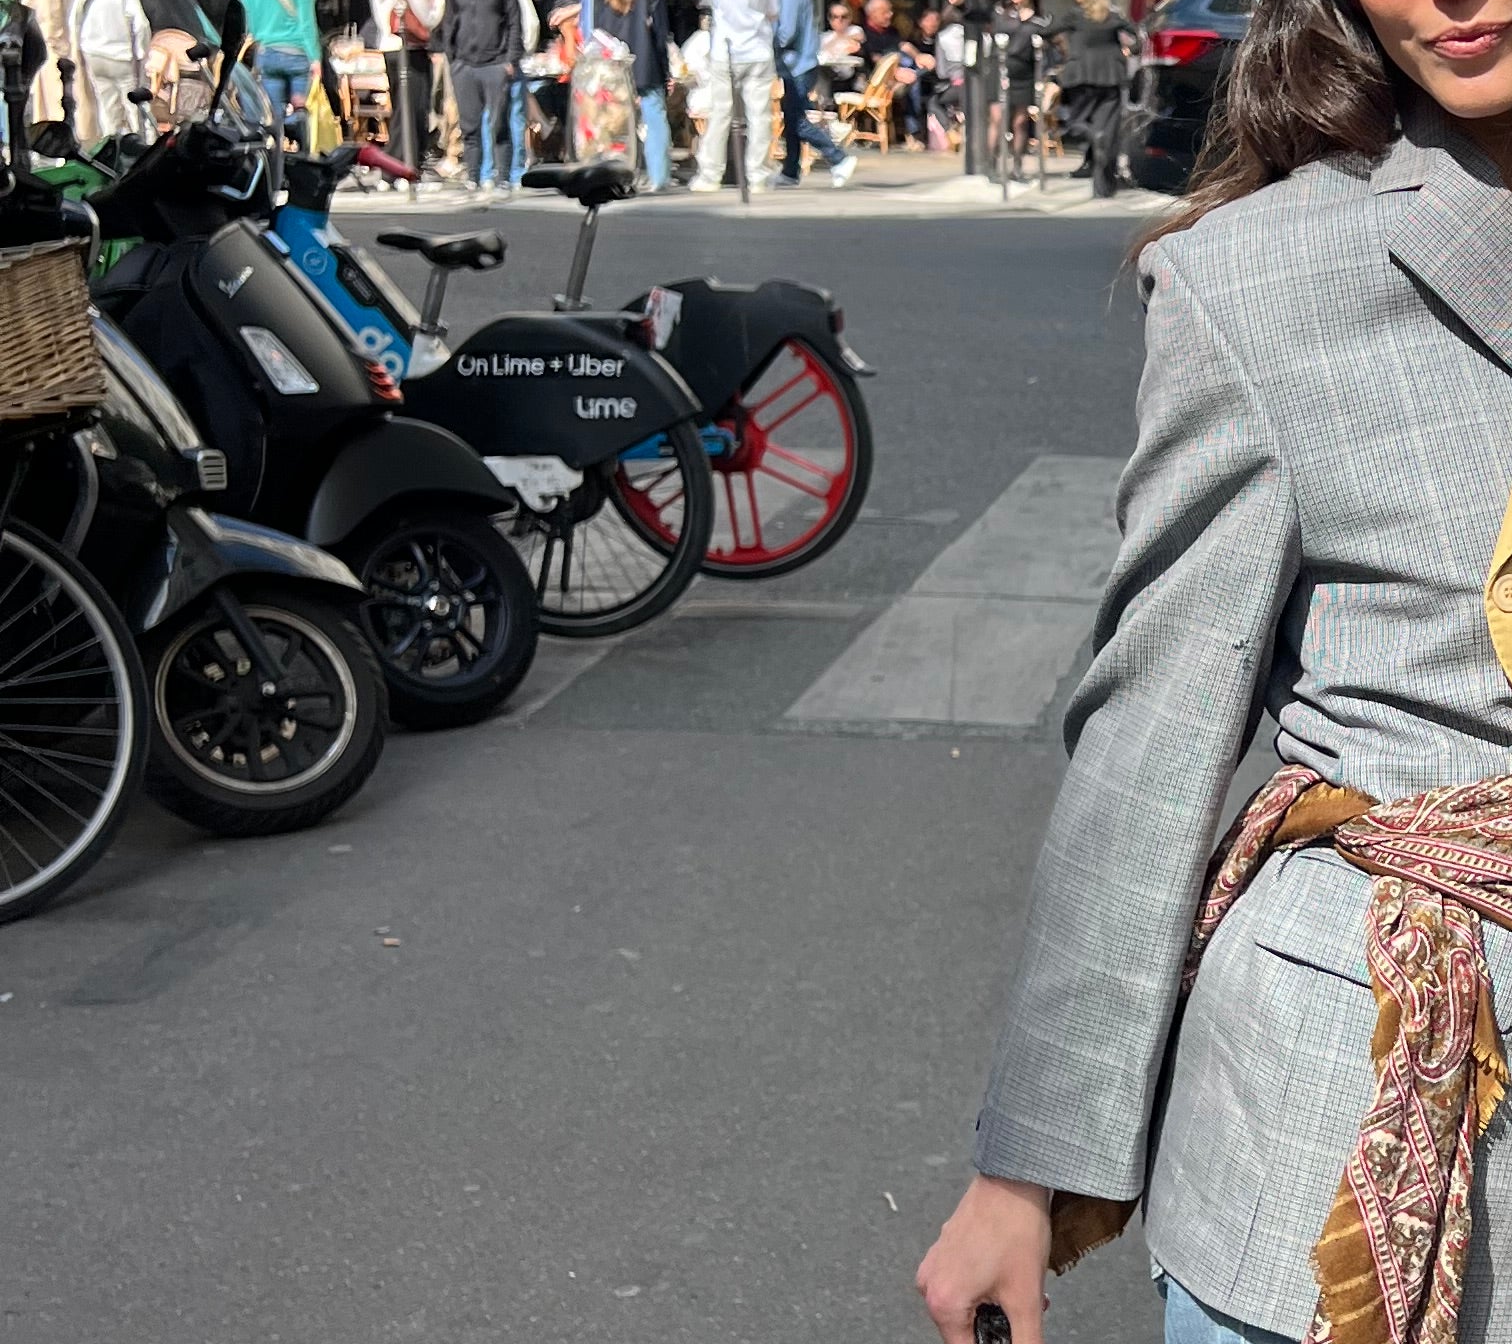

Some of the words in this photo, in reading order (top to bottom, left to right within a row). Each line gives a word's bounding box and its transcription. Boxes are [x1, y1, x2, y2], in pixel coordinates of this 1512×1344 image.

[457, 354, 489, 377] On
[492, 354, 545, 376] Lime
[568, 353, 625, 377] Uber
[573, 395, 638, 419] Lime
